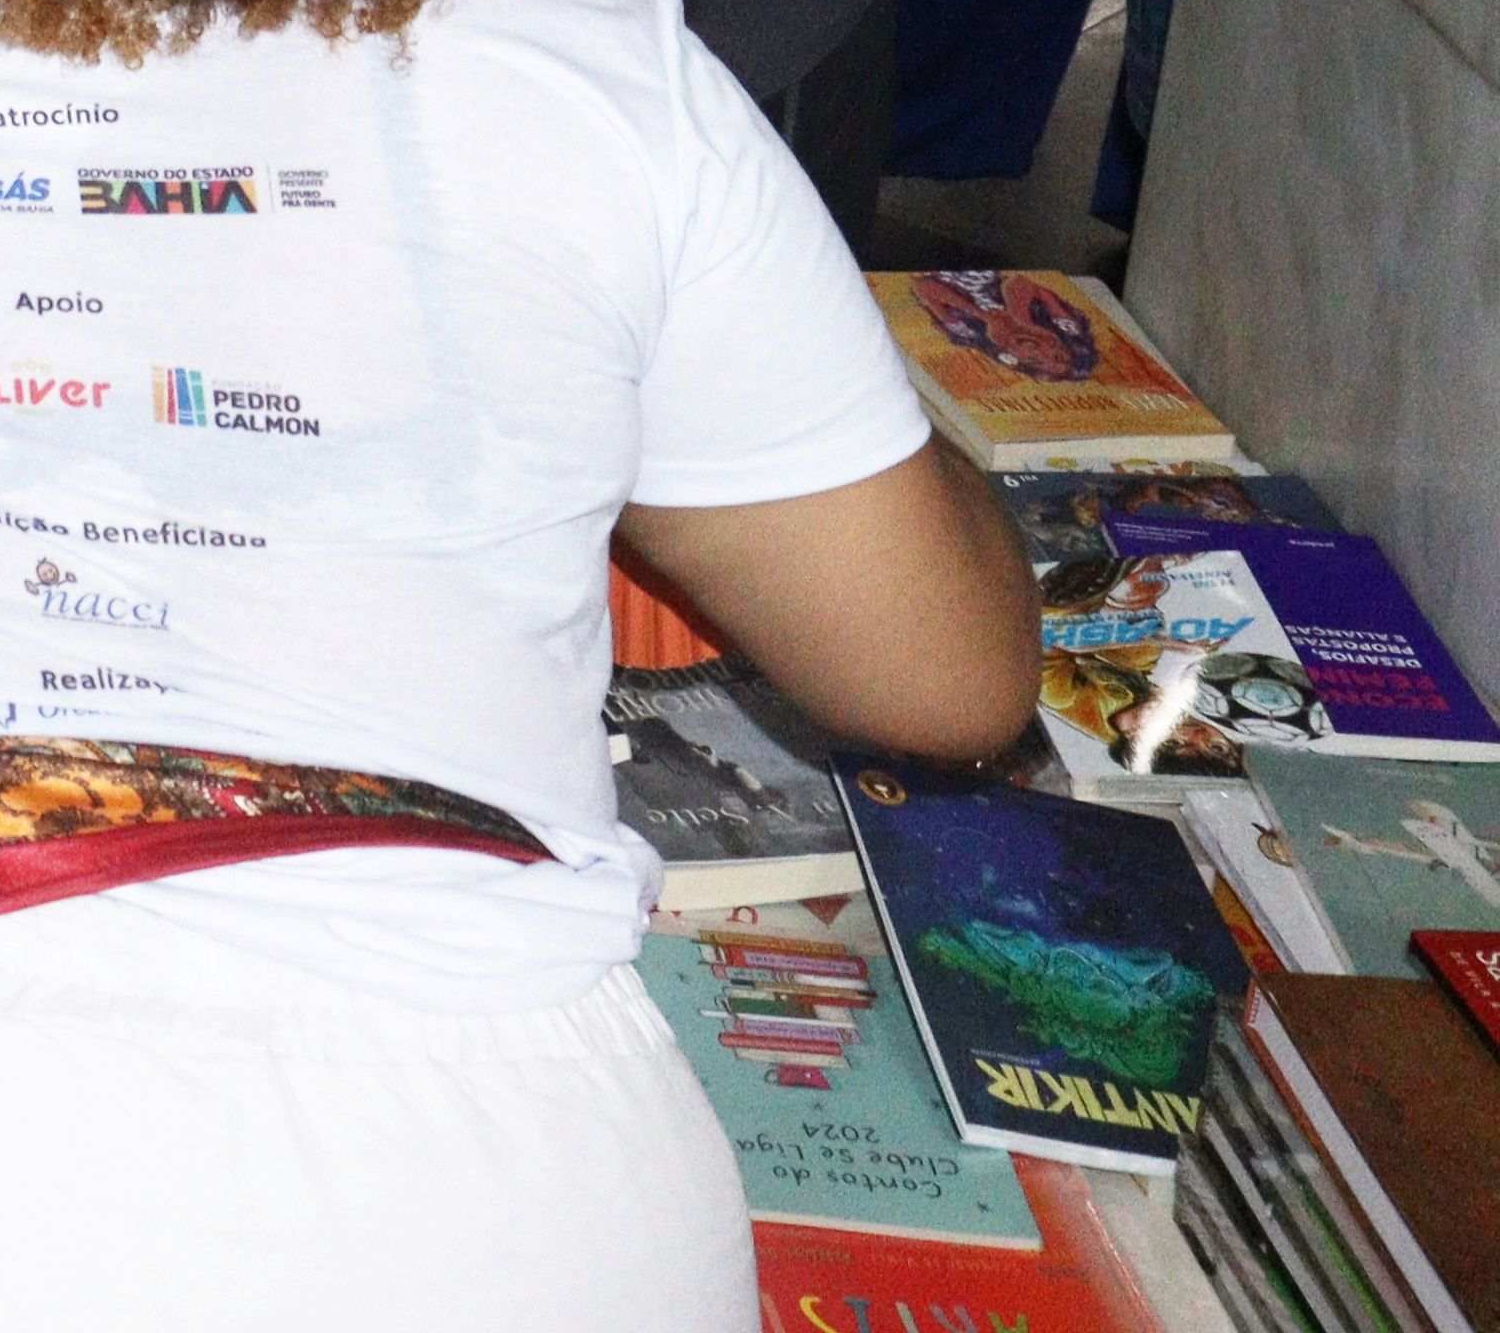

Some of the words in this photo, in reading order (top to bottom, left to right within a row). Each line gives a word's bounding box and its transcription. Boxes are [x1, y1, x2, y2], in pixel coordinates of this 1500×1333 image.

[78, 167, 158, 179] GOVERNO
[164, 167, 186, 180] DO
[192, 165, 254, 178] ESTADO
[79, 179, 259, 215] BAHIA
[16, 290, 104, 317] Apoio
[213, 391, 301, 414] PEDRO
[214, 411, 320, 437] CALMON
[1291, 635, 1416, 656] PROPOSTAS
[801, 1122, 880, 1144] 2024
[734, 1132, 805, 1162] Liga
[772, 1165, 811, 1187] do
[869, 1151, 959, 1177] Clube
[826, 1170, 942, 1200] Contos
